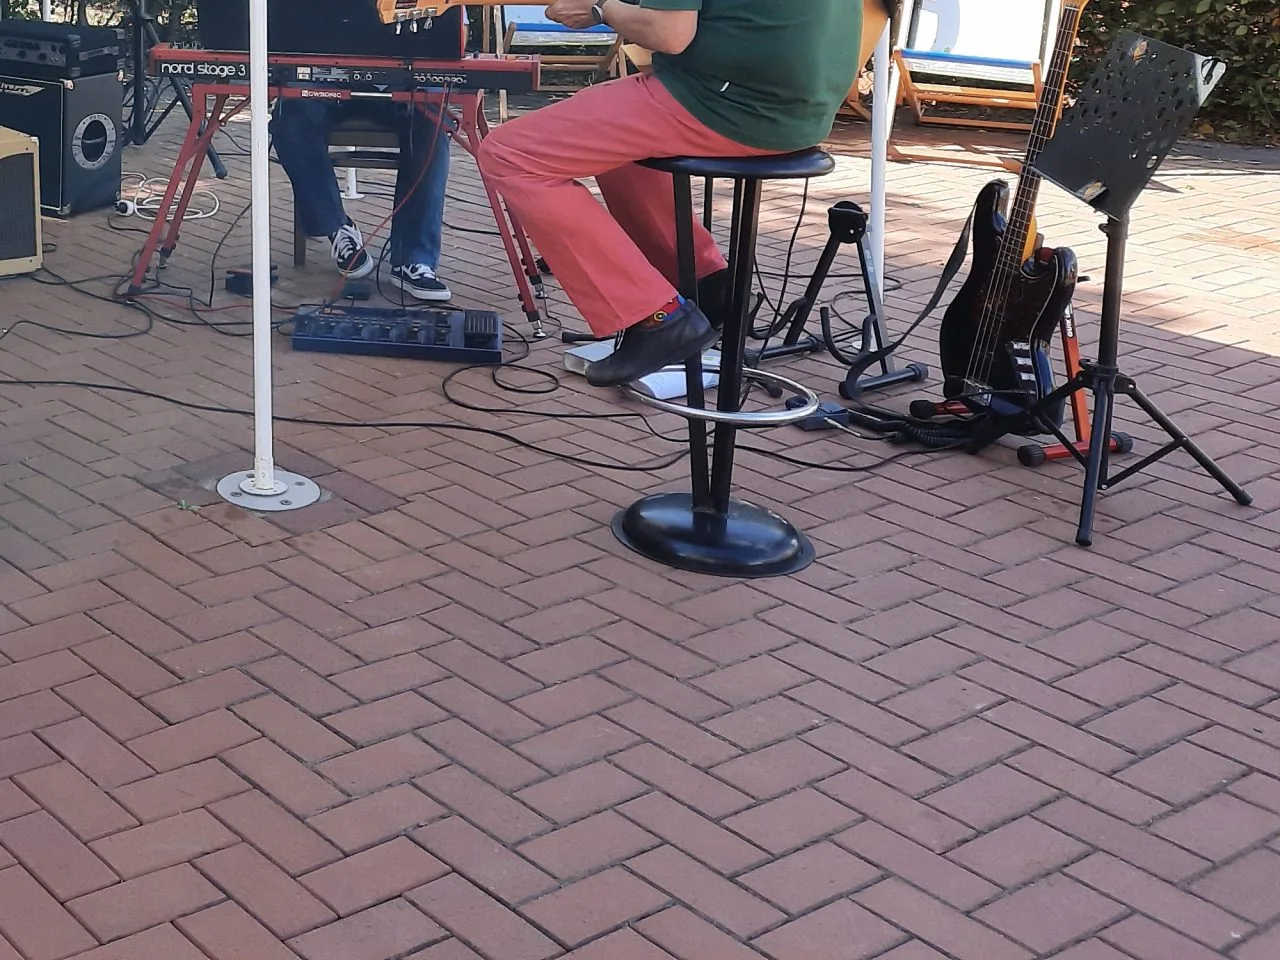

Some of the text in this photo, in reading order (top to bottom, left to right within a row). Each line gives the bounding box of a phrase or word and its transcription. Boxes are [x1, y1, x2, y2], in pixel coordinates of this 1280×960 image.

[161, 62, 246, 78] nord stage 3
